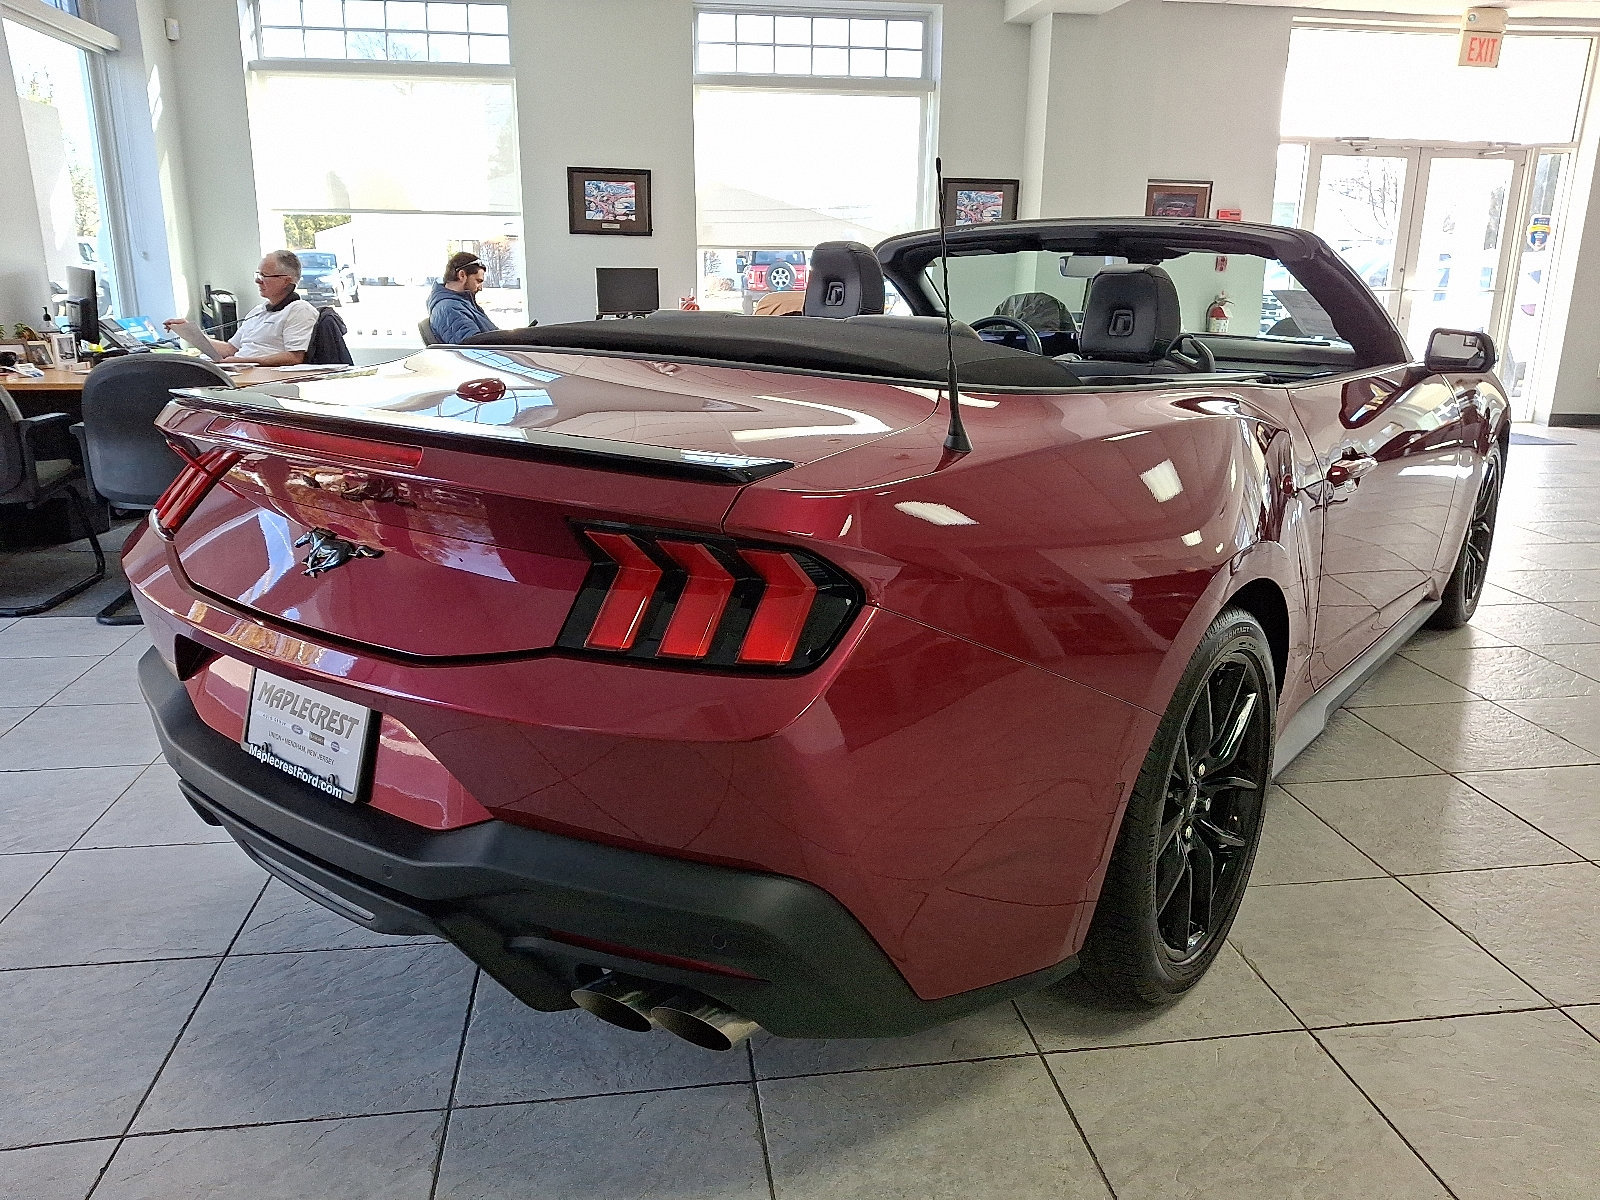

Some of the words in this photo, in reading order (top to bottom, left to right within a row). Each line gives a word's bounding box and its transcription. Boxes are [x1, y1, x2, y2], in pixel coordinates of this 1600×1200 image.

[1467, 37, 1498, 62] EXIT
[256, 681, 360, 740] MAPLECREST
[248, 743, 344, 799] MaplecrestFord.com
